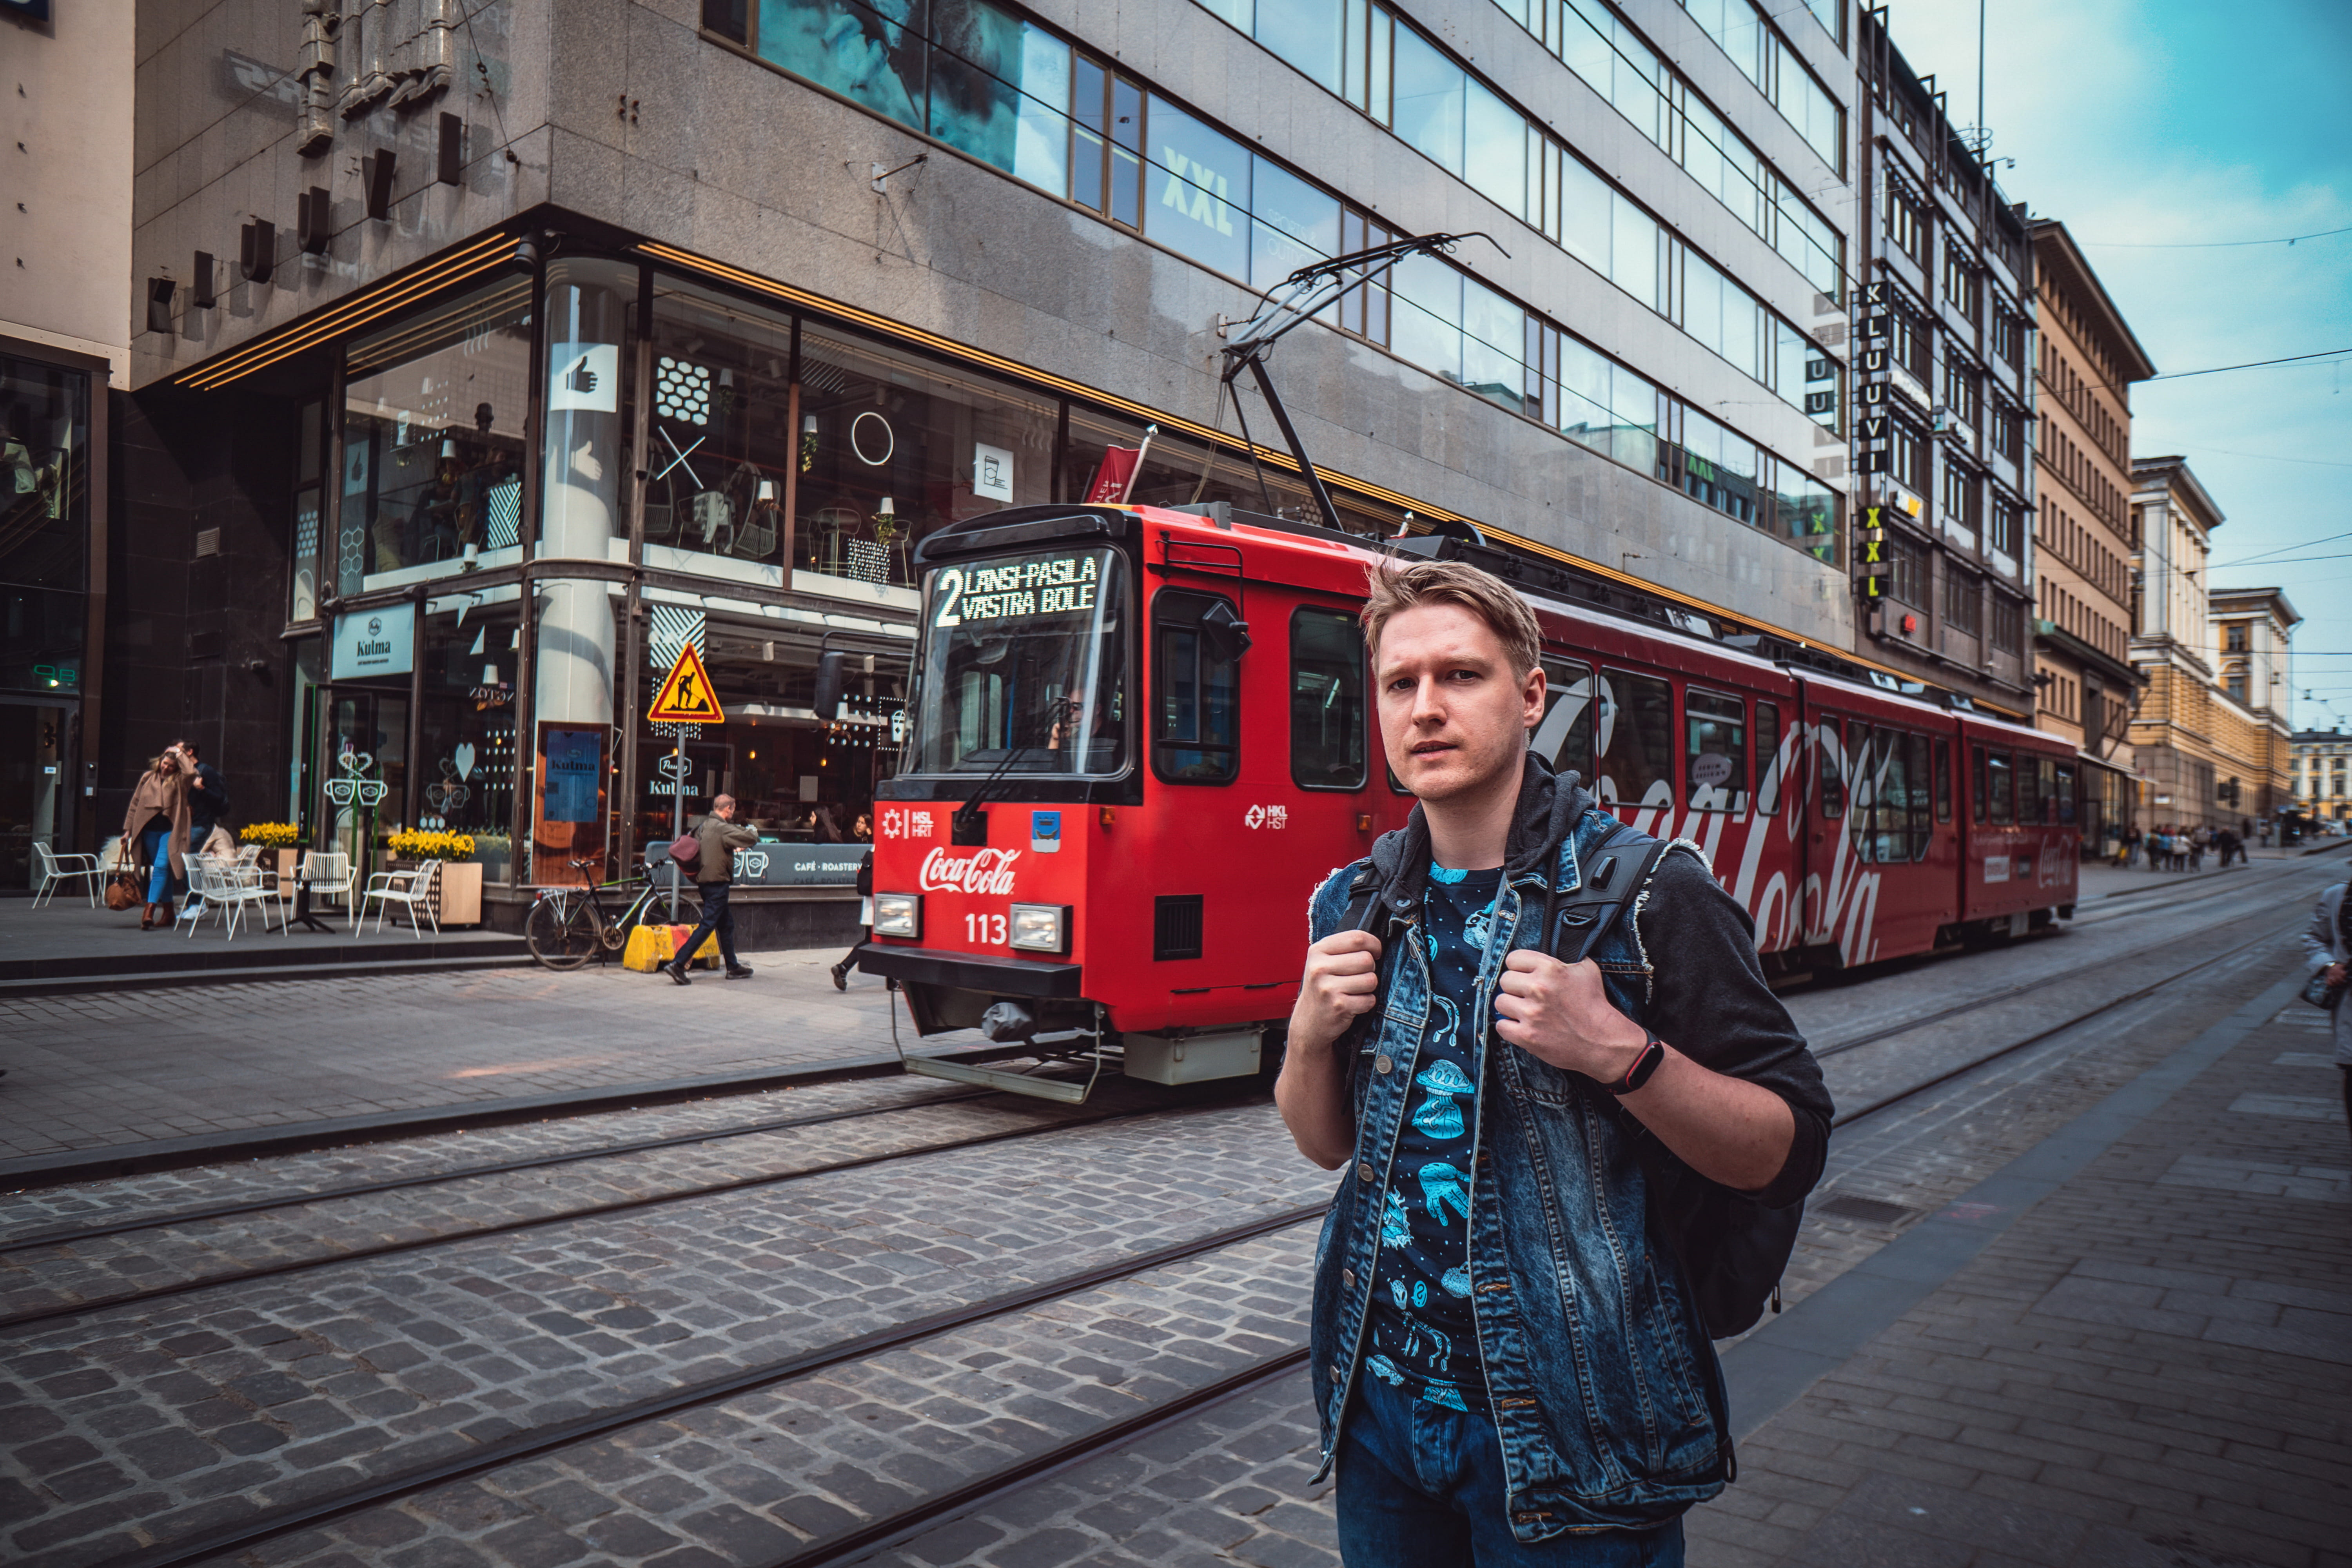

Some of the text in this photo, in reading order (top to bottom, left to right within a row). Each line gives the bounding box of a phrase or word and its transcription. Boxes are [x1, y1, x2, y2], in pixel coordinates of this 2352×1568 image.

[1162, 145, 1233, 238] XXL
[1267, 238, 1316, 269] OUTDO
[1866, 284, 1881, 471] KLUUVI
[1866, 507, 1880, 597] XXL
[935, 568, 964, 627] 2
[357, 639, 391, 657] Kulma
[551, 759, 595, 771] Kulma
[912, 811, 934, 824] HSL
[1267, 805, 1288, 817] HKL
[1267, 817, 1288, 829] HST
[912, 824, 934, 837] HRT
[795, 860, 863, 871] CAFÉ ROASTERY
[920, 846, 1023, 895] Coca-Cola
[965, 913, 1007, 945] 113
